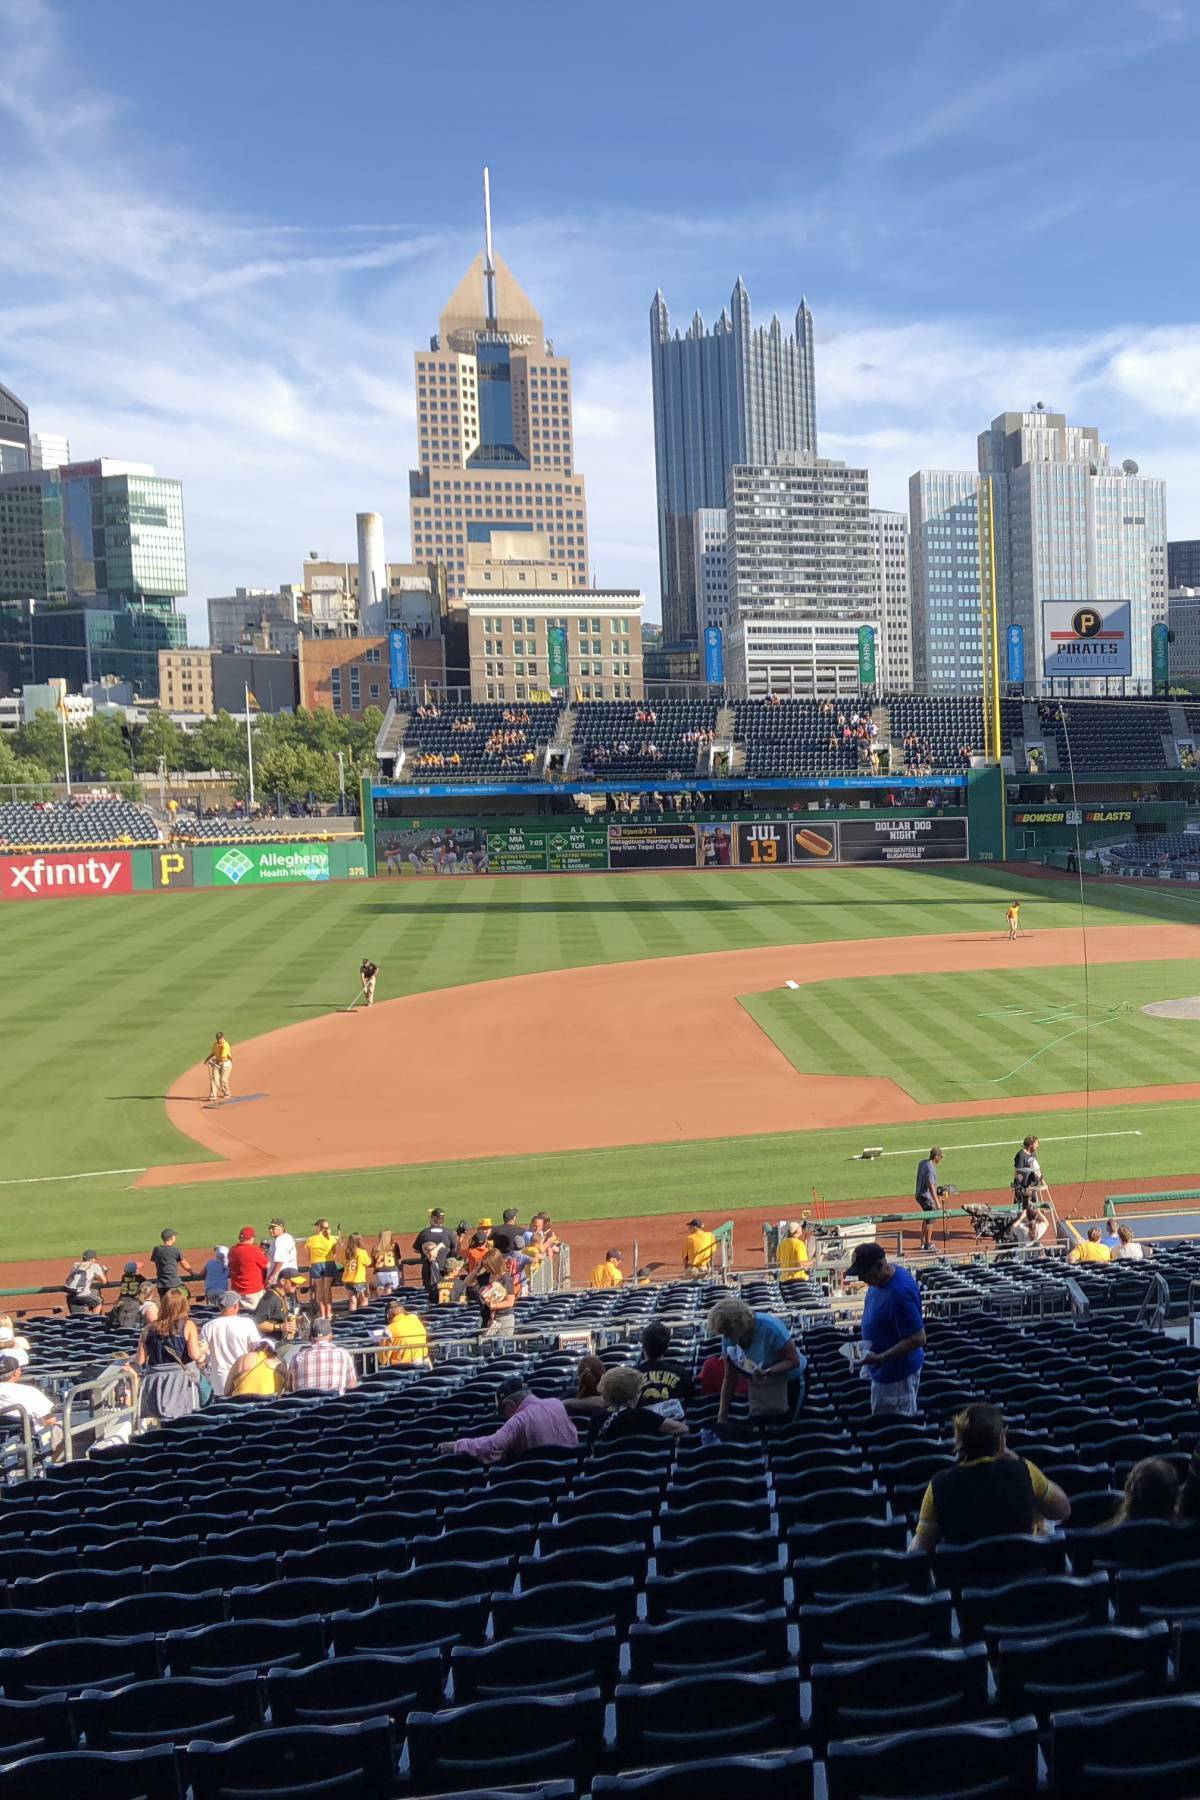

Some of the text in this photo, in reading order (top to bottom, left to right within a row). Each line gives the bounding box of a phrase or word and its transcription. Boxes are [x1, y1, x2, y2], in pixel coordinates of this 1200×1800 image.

[1081, 614, 1095, 633] P
[553, 645, 561, 664] AHN
[1057, 643, 1118, 655] PIRATES
[1057, 655, 1119, 664] CHARITIES
[584, 816, 663, 824] WELCOME
[710, 813, 738, 821] PNC
[753, 811, 794, 819] PARK
[1022, 814, 1064, 823] BOWSER
[1093, 812, 1131, 821] BLASTS
[747, 825, 780, 840] JUL
[875, 821, 932, 831] DOLLAR DOG
[890, 831, 917, 840] NIGHT
[750, 841, 777, 863] 13
[260, 852, 328, 868] Allegheny
[9, 858, 122, 893] xfinity
[161, 854, 184, 884] P
[260, 867, 328, 877] Health Network
[348, 867, 365, 876] 375
